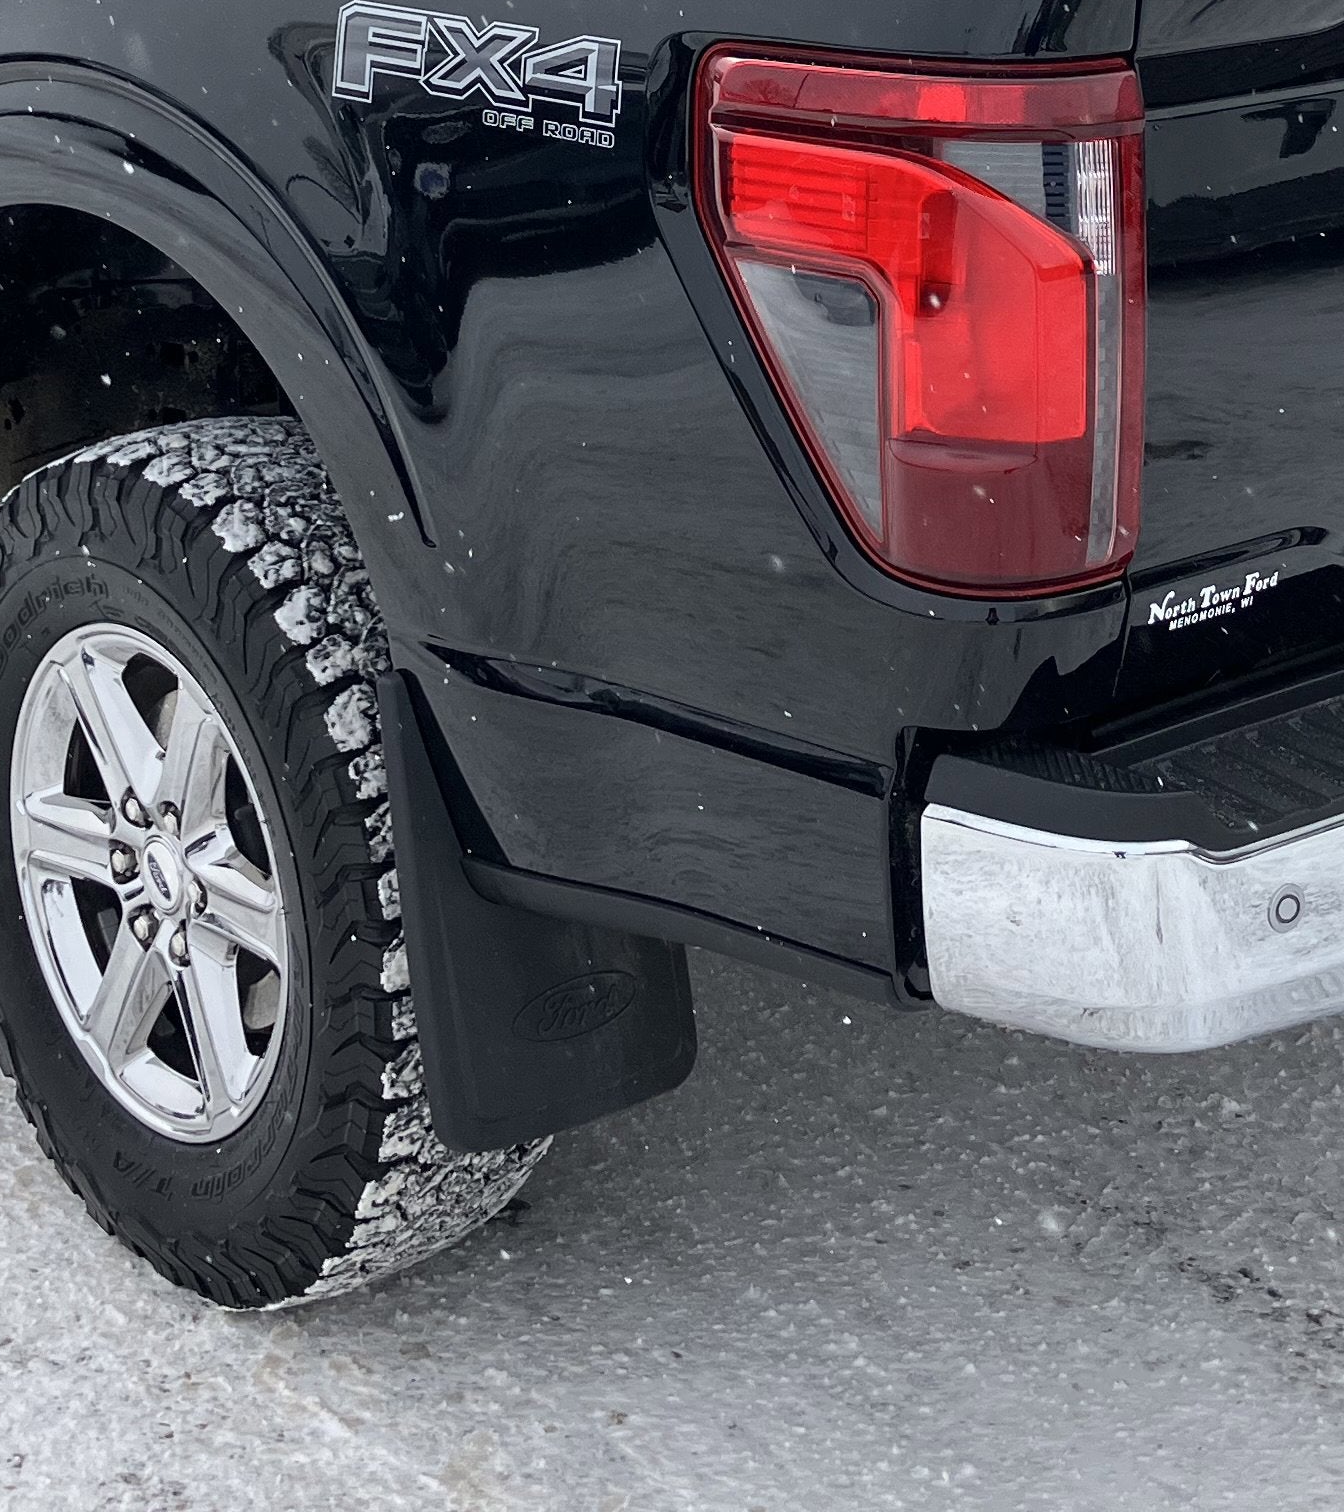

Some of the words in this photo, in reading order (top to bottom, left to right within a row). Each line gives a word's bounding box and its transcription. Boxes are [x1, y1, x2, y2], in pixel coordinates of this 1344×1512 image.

[332, 0, 622, 128] FX4
[482, 109, 534, 133] OFF
[542, 120, 615, 149] ROAD
[1147, 590, 1196, 625] North
[1199, 584, 1240, 608] Town
[1242, 571, 1279, 596] Ford
[1168, 604, 1236, 631] MENOMONIE,
[1240, 595, 1254, 609] WI
[536, 982, 618, 1038] Ford
